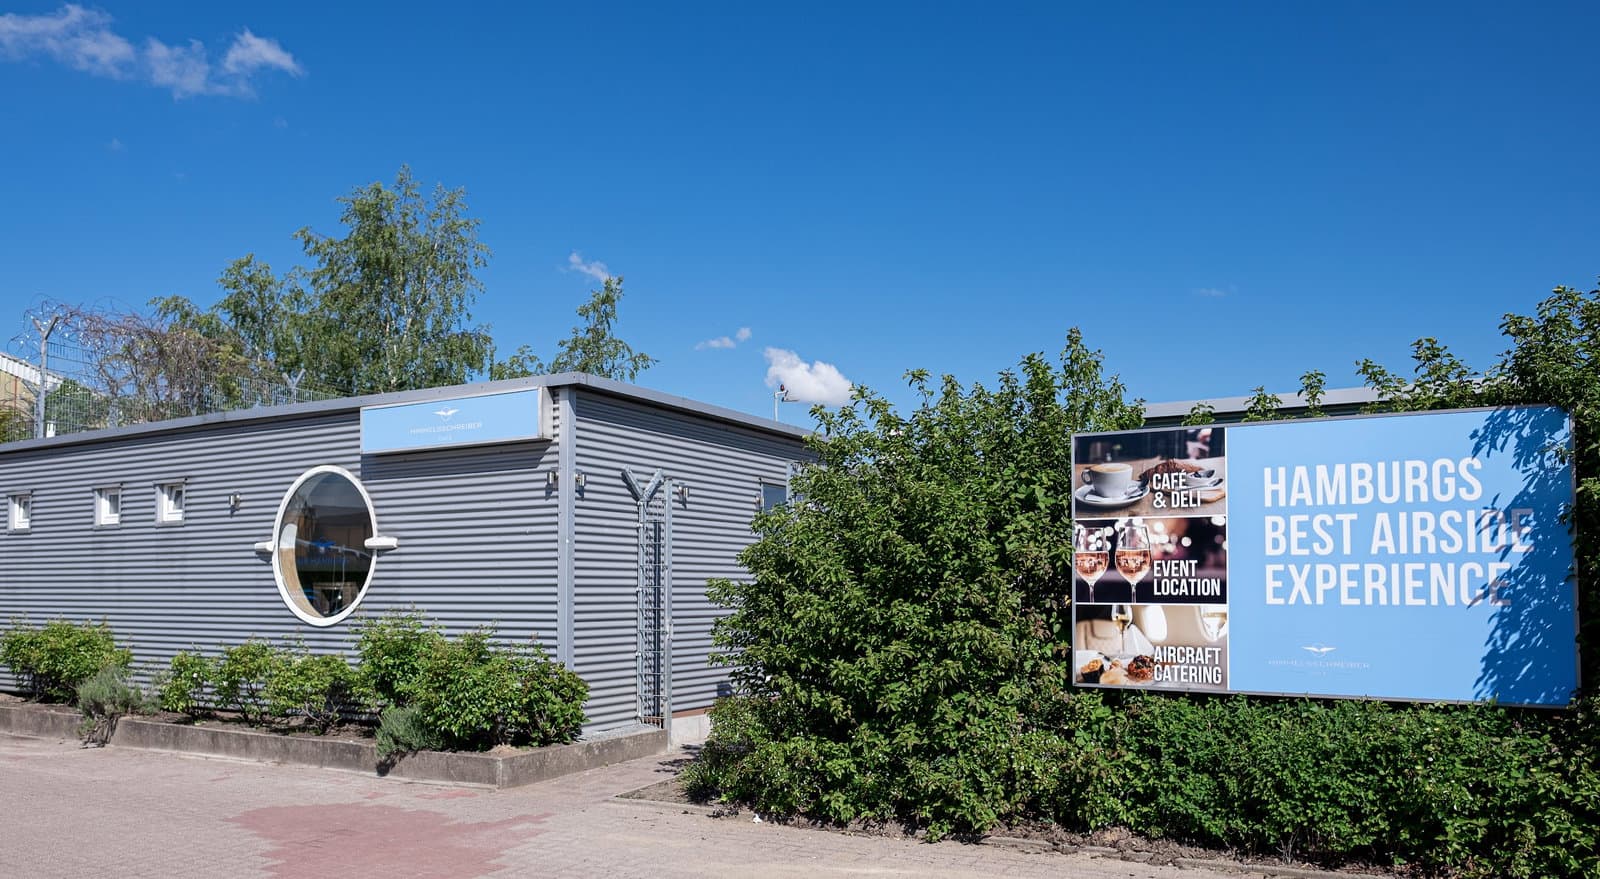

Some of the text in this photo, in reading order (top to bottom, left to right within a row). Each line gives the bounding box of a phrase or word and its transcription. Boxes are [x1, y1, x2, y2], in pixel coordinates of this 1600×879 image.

[1152, 469, 1187, 490] CAFÉ
[1263, 457, 1483, 507] HAMBURGS
[1153, 490, 1201, 509] & DELI
[1264, 508, 1535, 556] BEST AIRSIDE
[1153, 559, 1198, 577] EVENT
[1153, 578, 1221, 596] LOCATION
[1265, 562, 1512, 606] EXPERIENCE
[1153, 645, 1222, 665] AIRCRAFT
[1153, 664, 1222, 685] CATERING
